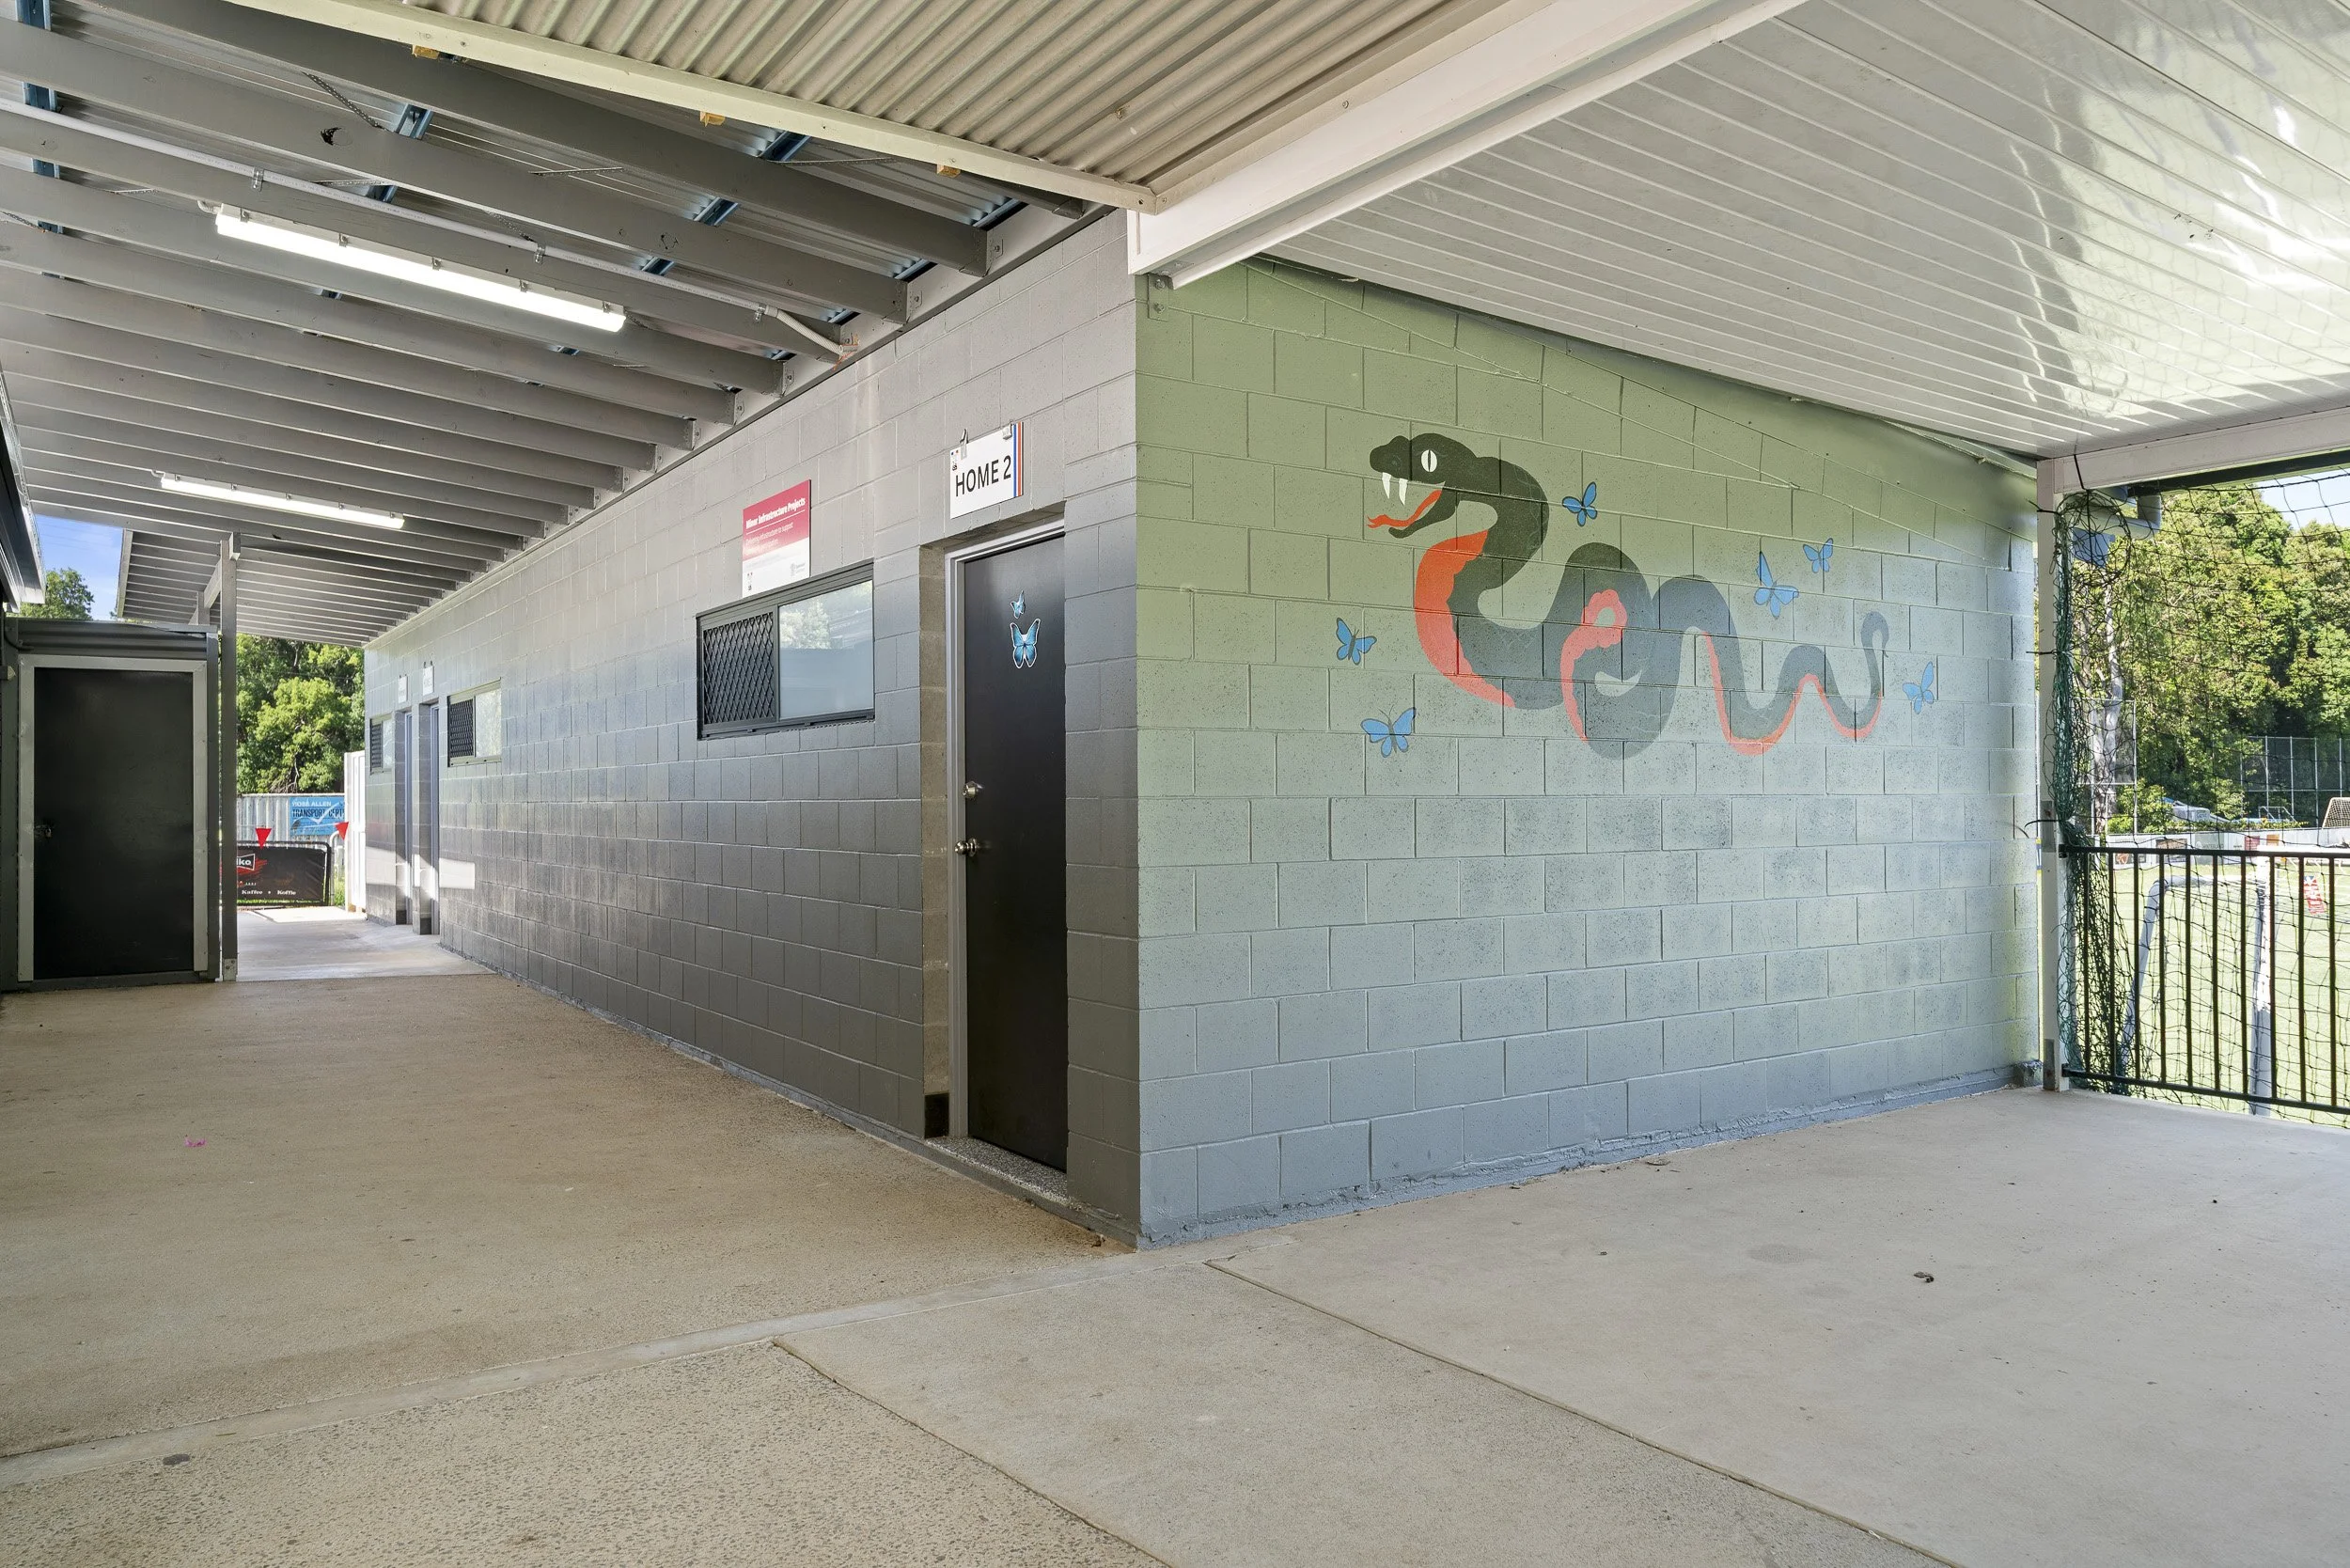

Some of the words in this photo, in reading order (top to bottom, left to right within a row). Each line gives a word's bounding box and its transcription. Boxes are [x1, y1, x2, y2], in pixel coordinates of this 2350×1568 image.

[955, 459, 999, 497] HOME
[1003, 455, 1011, 480] 2
[758, 507, 788, 524] Infrastructure
[788, 497, 806, 510] Projects
[292, 808, 325, 818] TRANSPORT
